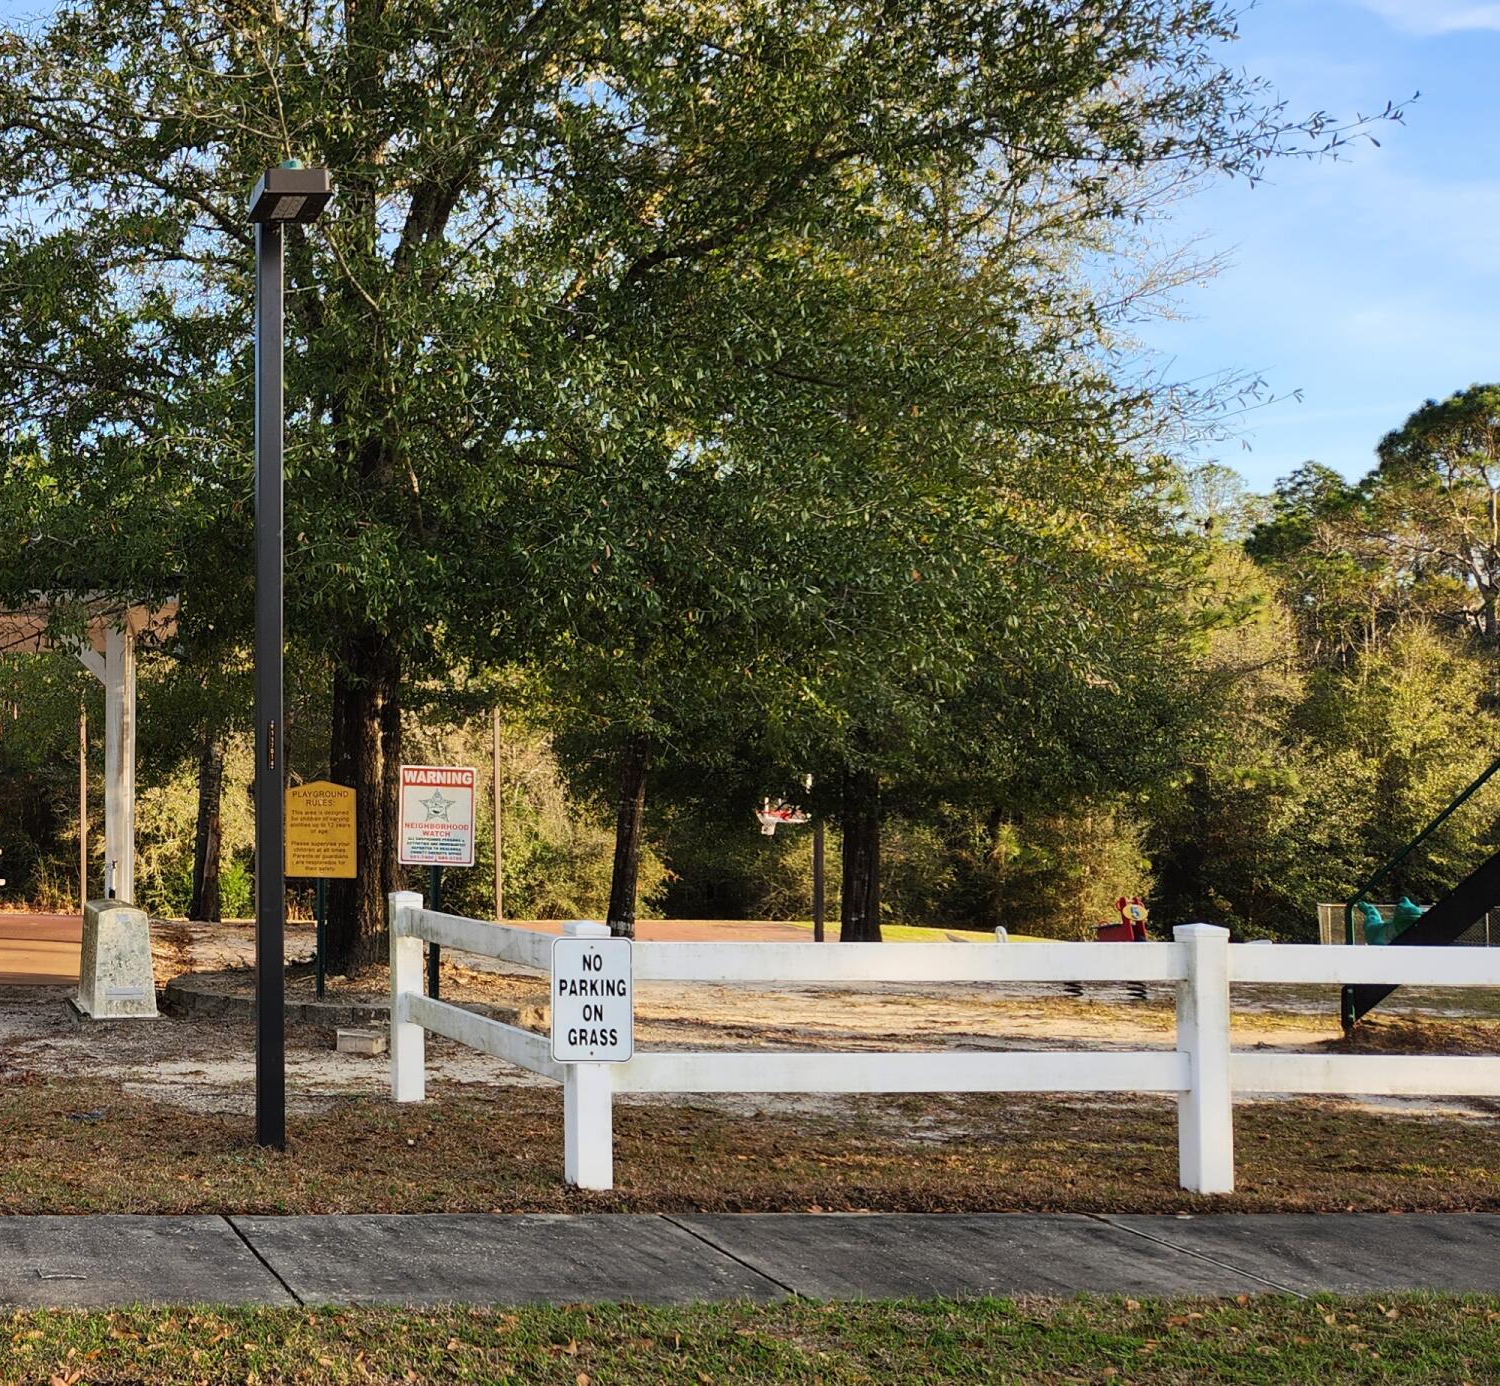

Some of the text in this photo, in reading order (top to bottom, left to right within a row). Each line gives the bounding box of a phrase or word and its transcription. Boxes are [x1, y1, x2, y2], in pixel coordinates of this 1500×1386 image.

[404, 770, 473, 784] WARNING
[292, 790, 349, 798] PLAYGROUND
[306, 799, 335, 807] RULES:
[582, 954, 603, 972] NO
[559, 979, 627, 997] PARKING
[582, 1004, 603, 1022] ON
[568, 1028, 618, 1046] GRASS
